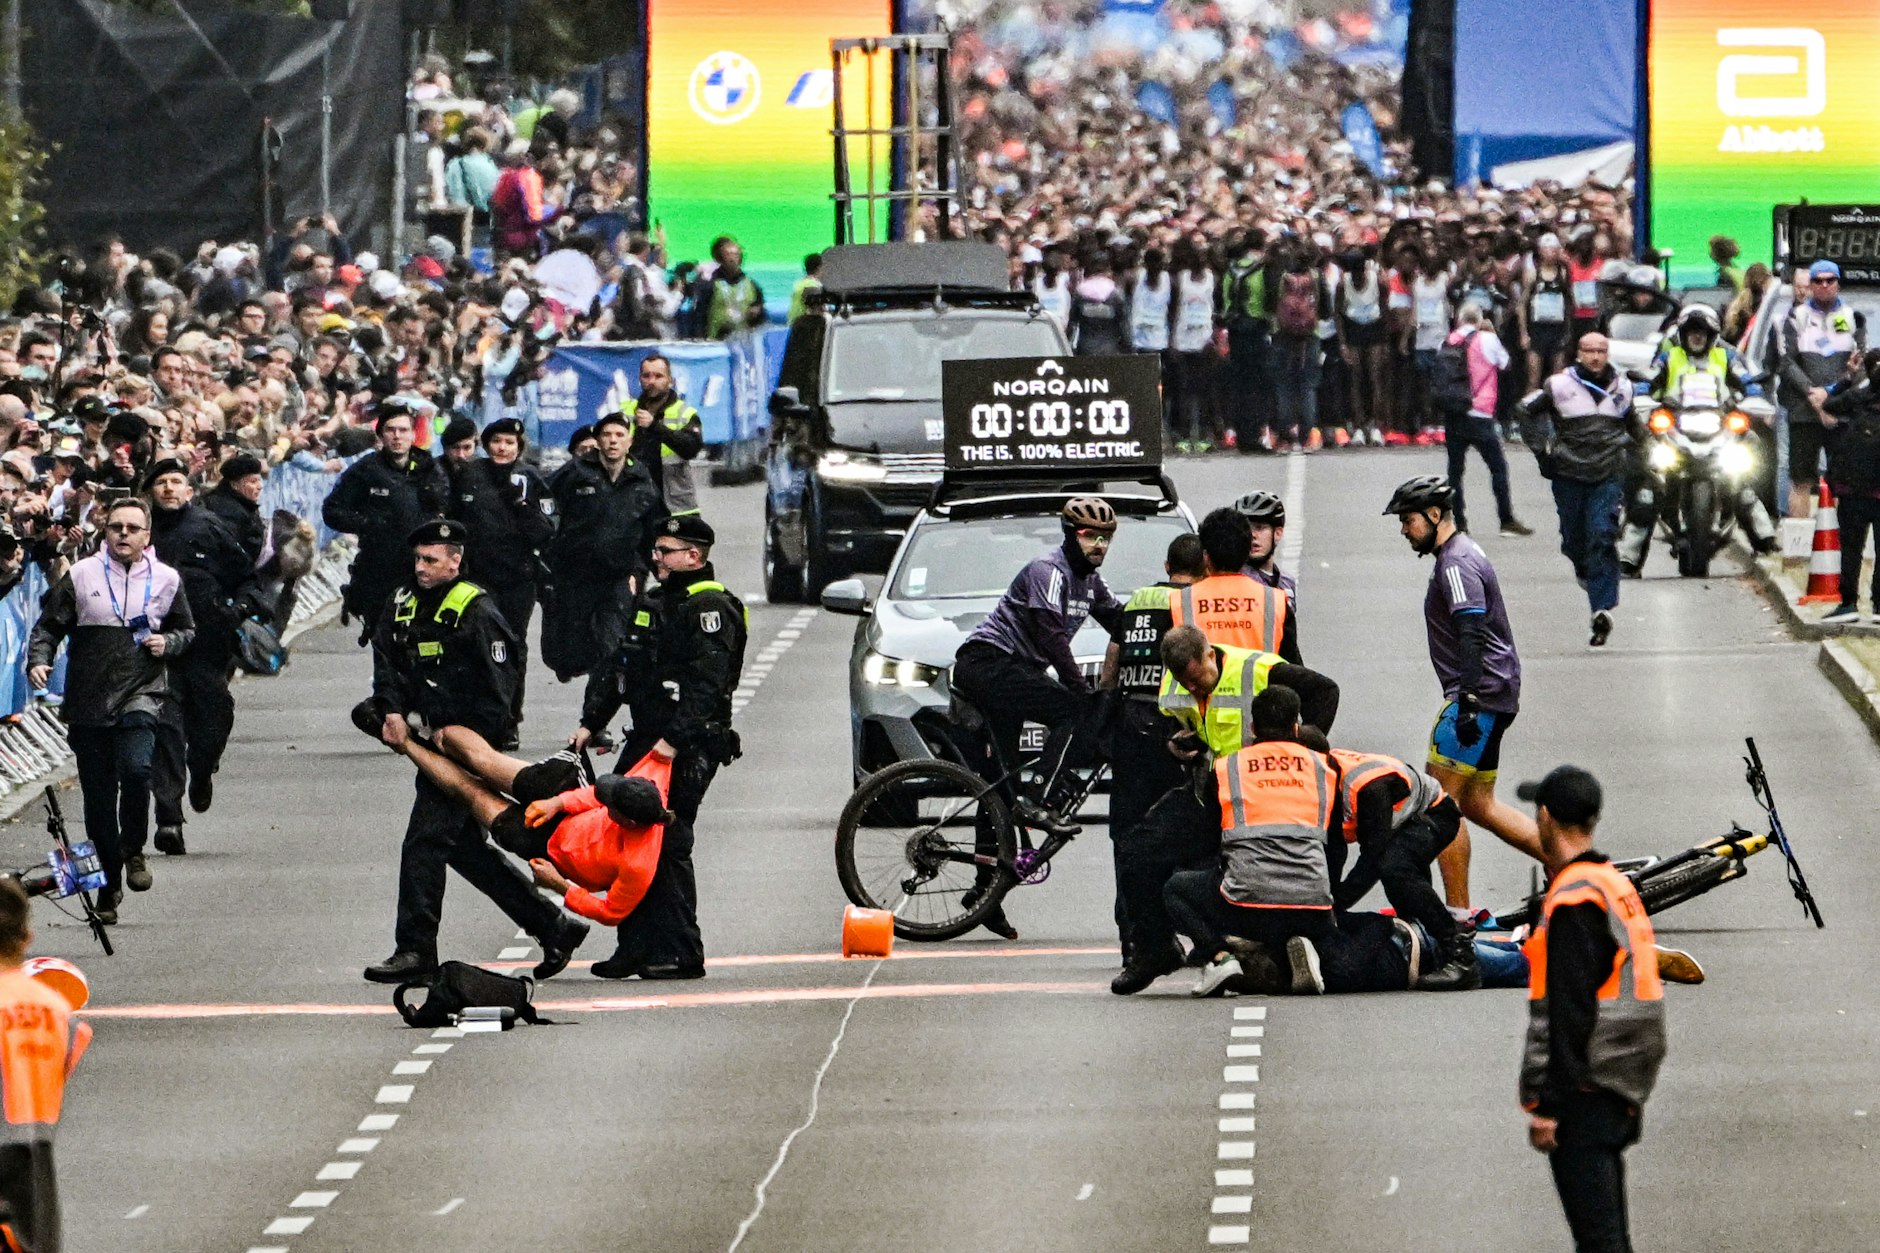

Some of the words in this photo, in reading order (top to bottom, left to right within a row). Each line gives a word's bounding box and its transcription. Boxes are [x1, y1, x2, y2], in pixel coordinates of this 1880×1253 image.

[993, 378, 1109, 396] NORQAIN
[971, 400, 1130, 438] 00:00:00
[960, 446, 993, 460] THE
[1018, 444, 1063, 459] 100%
[1065, 442, 1144, 459] ELECTRIC.
[1135, 615, 1151, 628] BE
[1206, 620, 1252, 630] STEWARD
[1124, 629, 1157, 643] 16133
[1257, 778, 1305, 789] STEWARD
